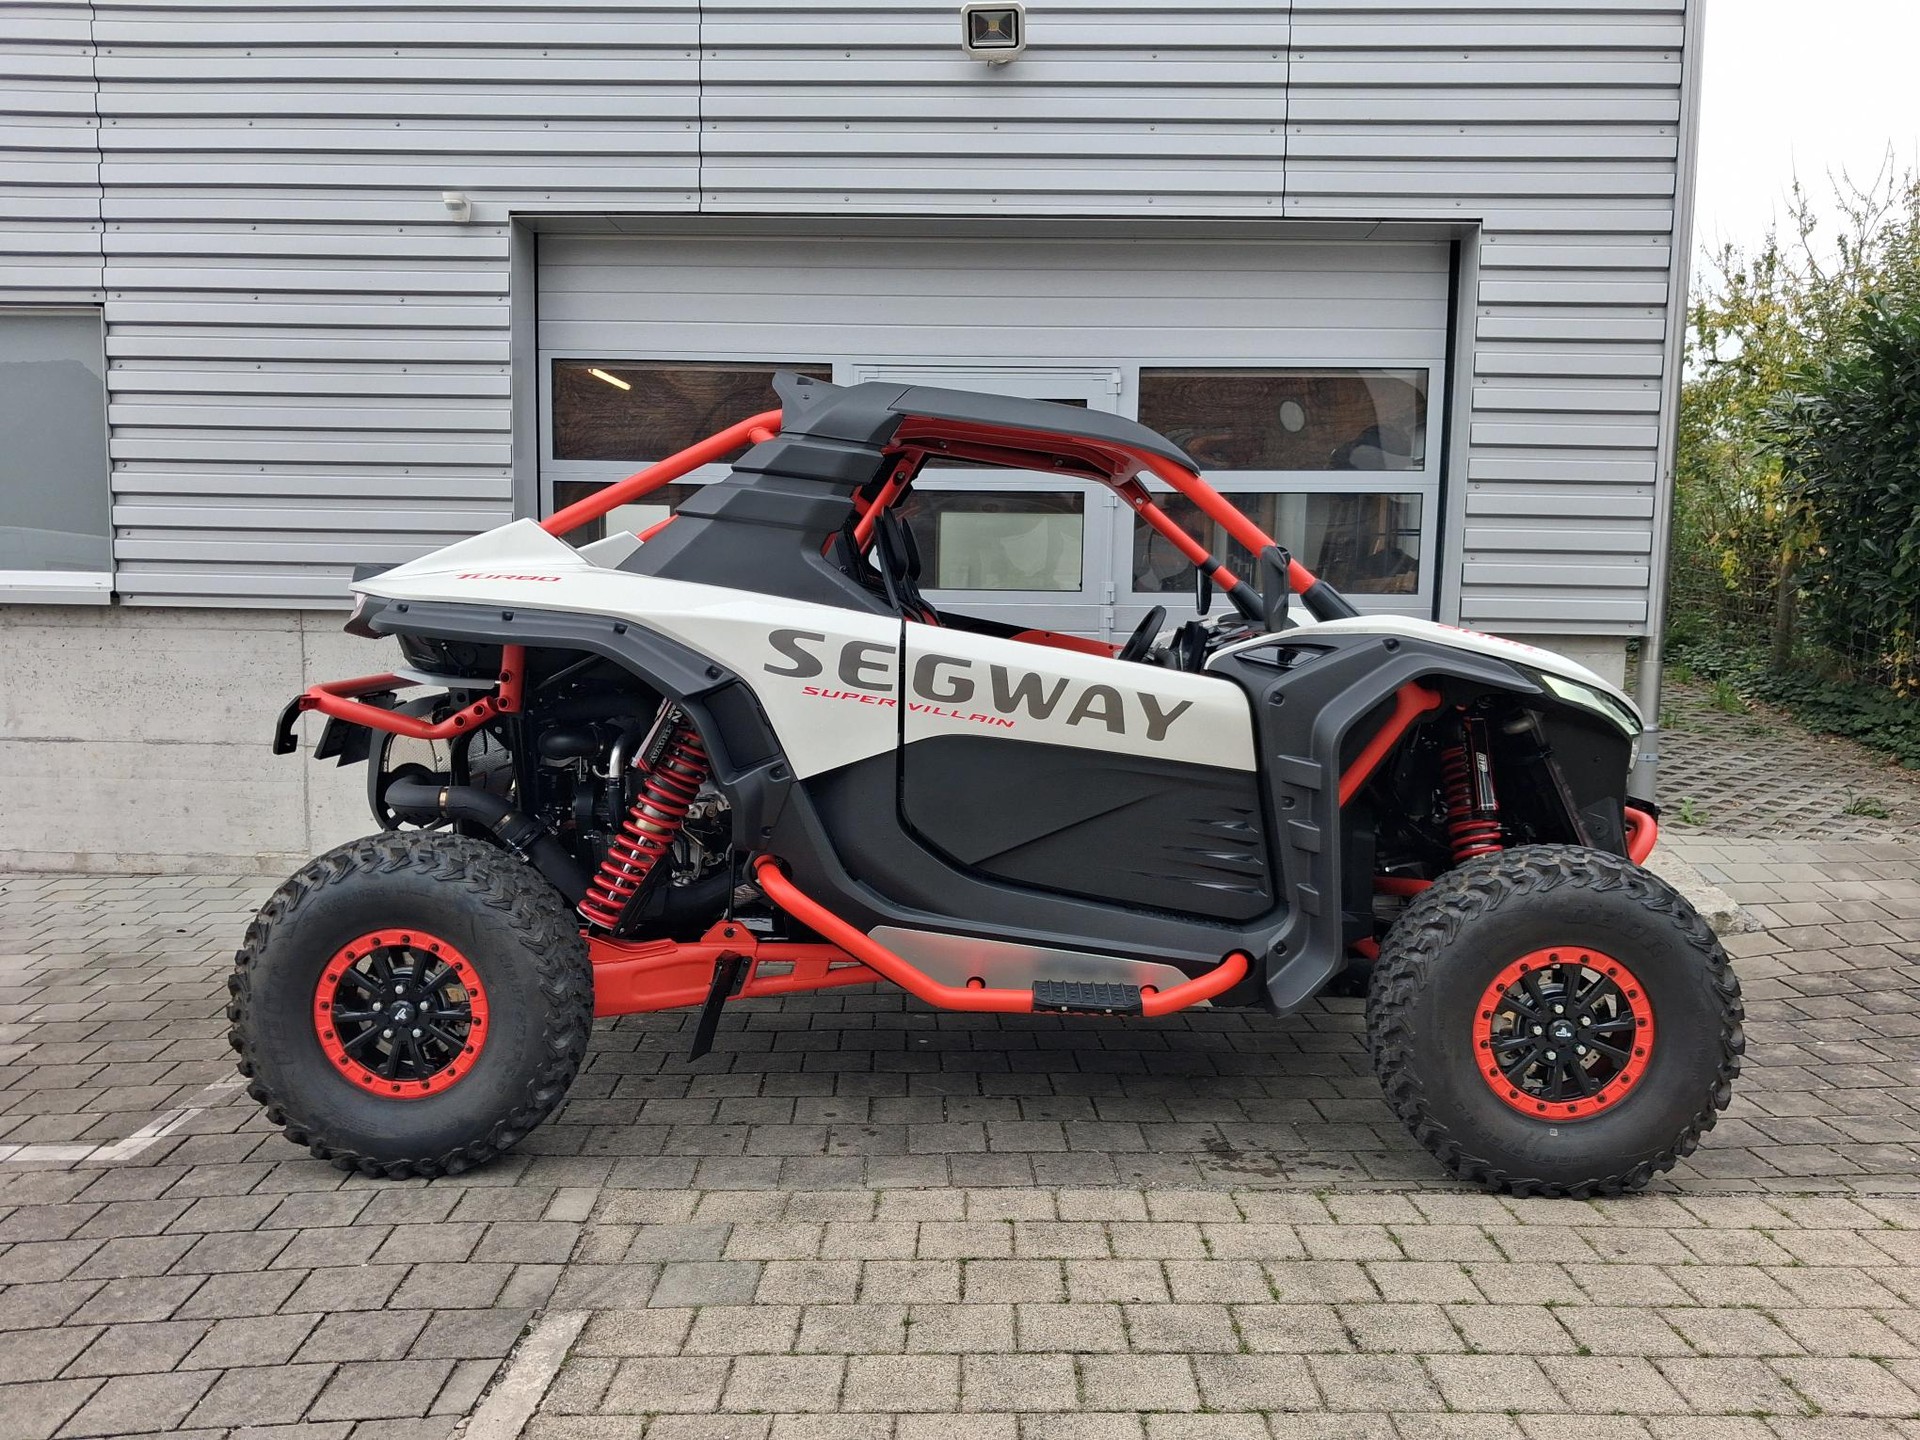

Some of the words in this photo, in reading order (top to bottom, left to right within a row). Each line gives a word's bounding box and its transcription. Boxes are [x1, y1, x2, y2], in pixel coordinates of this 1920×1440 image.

[456, 572, 562, 583] TURBO
[763, 628, 1194, 742] SEGWAY
[801, 685, 898, 709] SUPER
[907, 701, 1016, 729] VILLAIN
